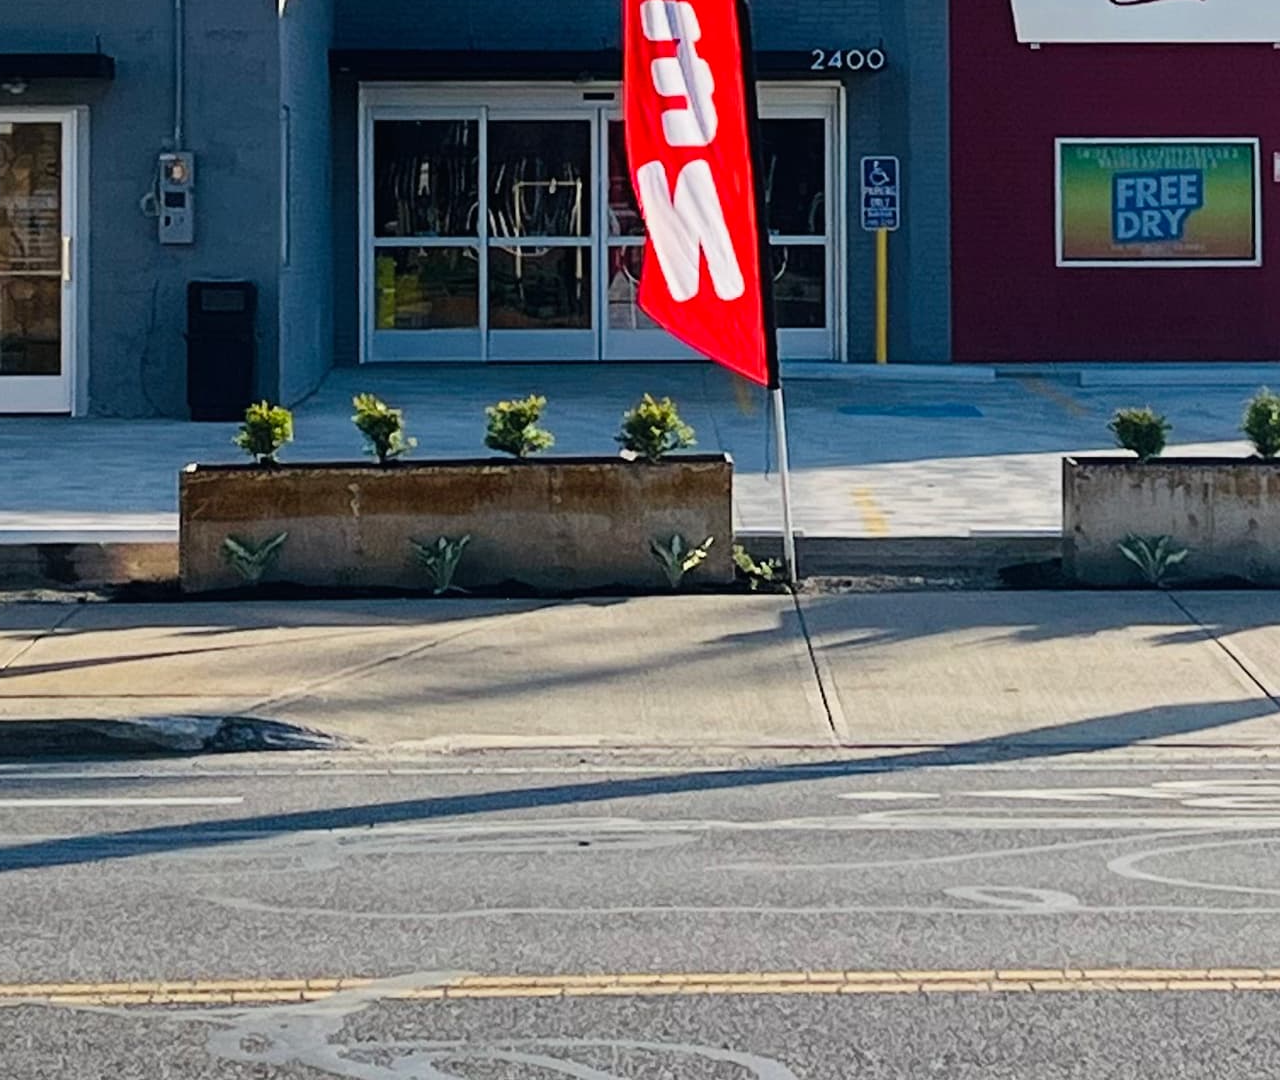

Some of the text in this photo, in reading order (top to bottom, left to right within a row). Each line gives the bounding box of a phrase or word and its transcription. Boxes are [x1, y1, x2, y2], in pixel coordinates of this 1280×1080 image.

[810, 48, 885, 70] 2400
[1116, 174, 1199, 209] FREE
[1116, 208, 1187, 239] DRY
